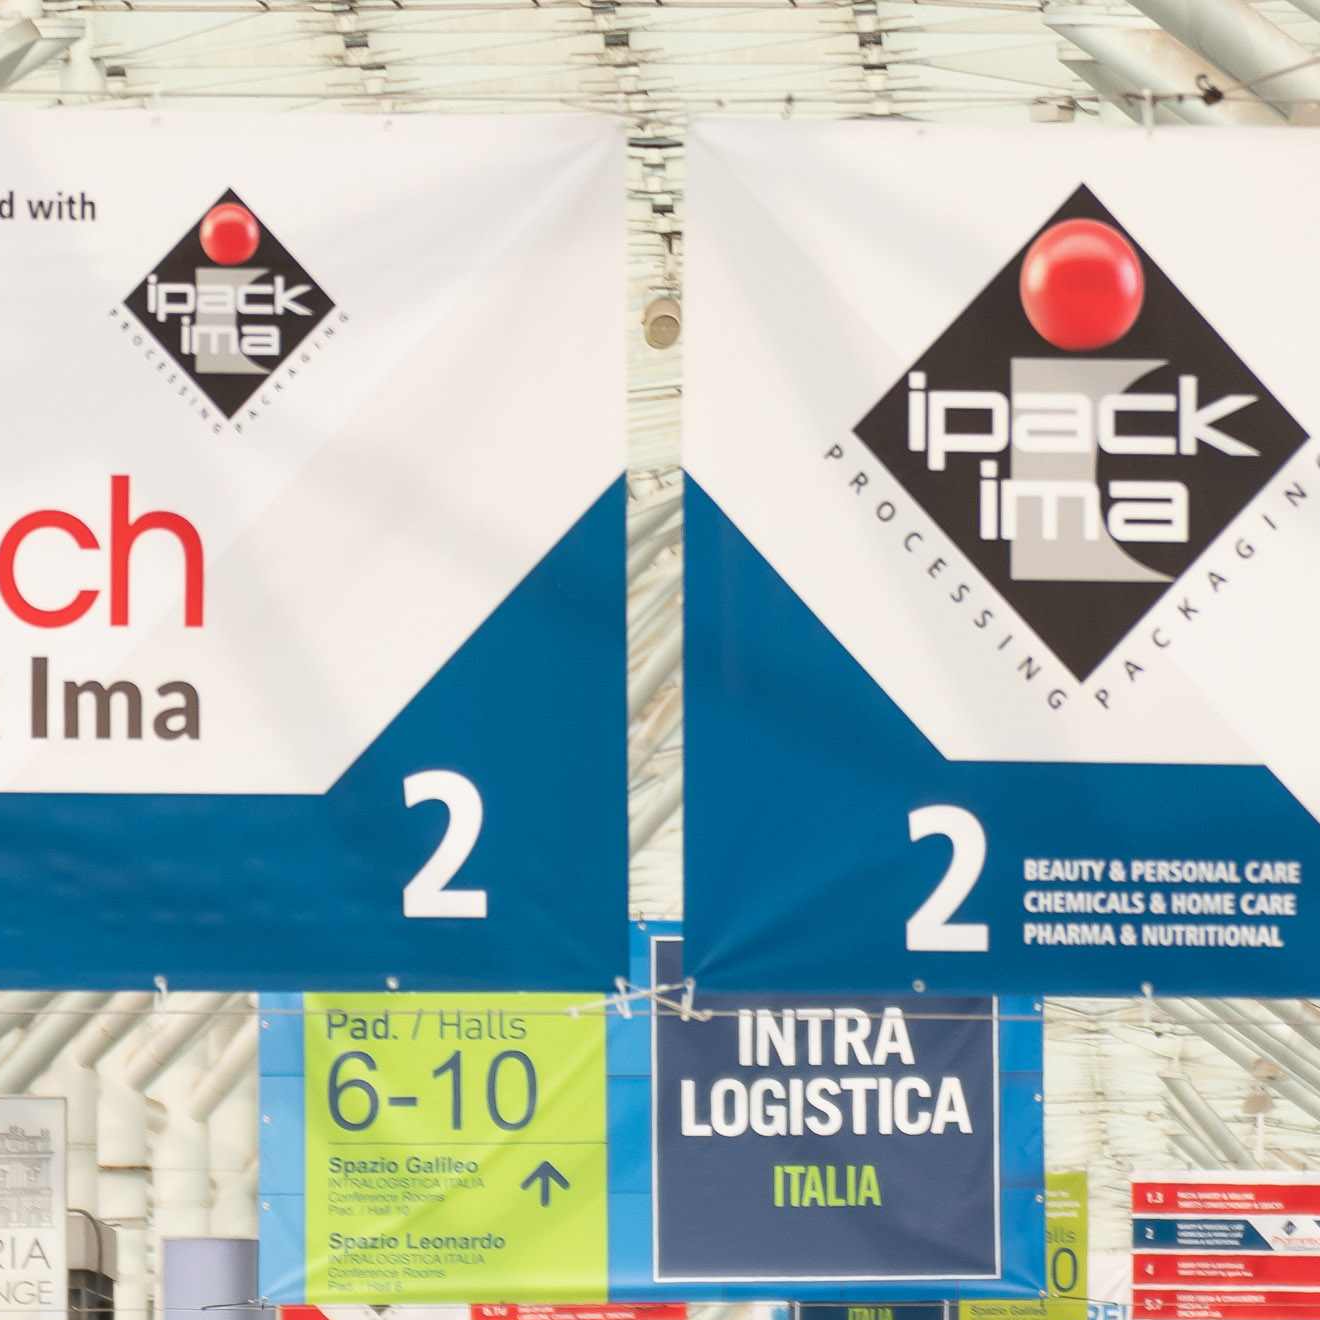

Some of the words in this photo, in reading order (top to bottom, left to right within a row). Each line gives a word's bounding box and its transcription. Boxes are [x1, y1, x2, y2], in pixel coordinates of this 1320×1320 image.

[27, 193, 97, 221] with
[147, 273, 315, 322] ipack
[181, 316, 281, 356] ima
[106, 307, 223, 435] PROCESSING
[234, 311, 351, 435] PACKAGING
[908, 371, 1262, 471] ipack
[979, 459, 1190, 542] ima
[823, 443, 1067, 711] PROCESSING
[30, 657, 202, 740] Ima
[402, 769, 488, 918] 2
[1024, 859, 1105, 882] BEAUTY
[1109, 860, 1127, 882] &
[1131, 860, 1241, 884] PERSONAL
[1245, 861, 1301, 884] CARE
[905, 804, 989, 952] 2
[1024, 891, 1145, 914] CHEMICALS
[1149, 892, 1167, 914] &
[1171, 892, 1236, 915] HOME
[1240, 893, 1297, 916] CARE
[1024, 923, 1115, 945] PHARMA
[1119, 924, 1137, 946] &
[1141, 924, 1284, 948] NUTRITIONAL
[327, 1010, 398, 1041] Pad.
[439, 1009, 527, 1041] Halls
[738, 1007, 915, 1067] INTRA
[328, 1050, 538, 1132] 6-10
[680, 1077, 973, 1137] LOGISTICA
[329, 1157, 399, 1177] Spazio
[406, 1157, 479, 1173] Galileo
[773, 1165, 882, 1207] ITALIA
[329, 1233, 399, 1253] Spazio
[406, 1233, 506, 1249] Leonardo
